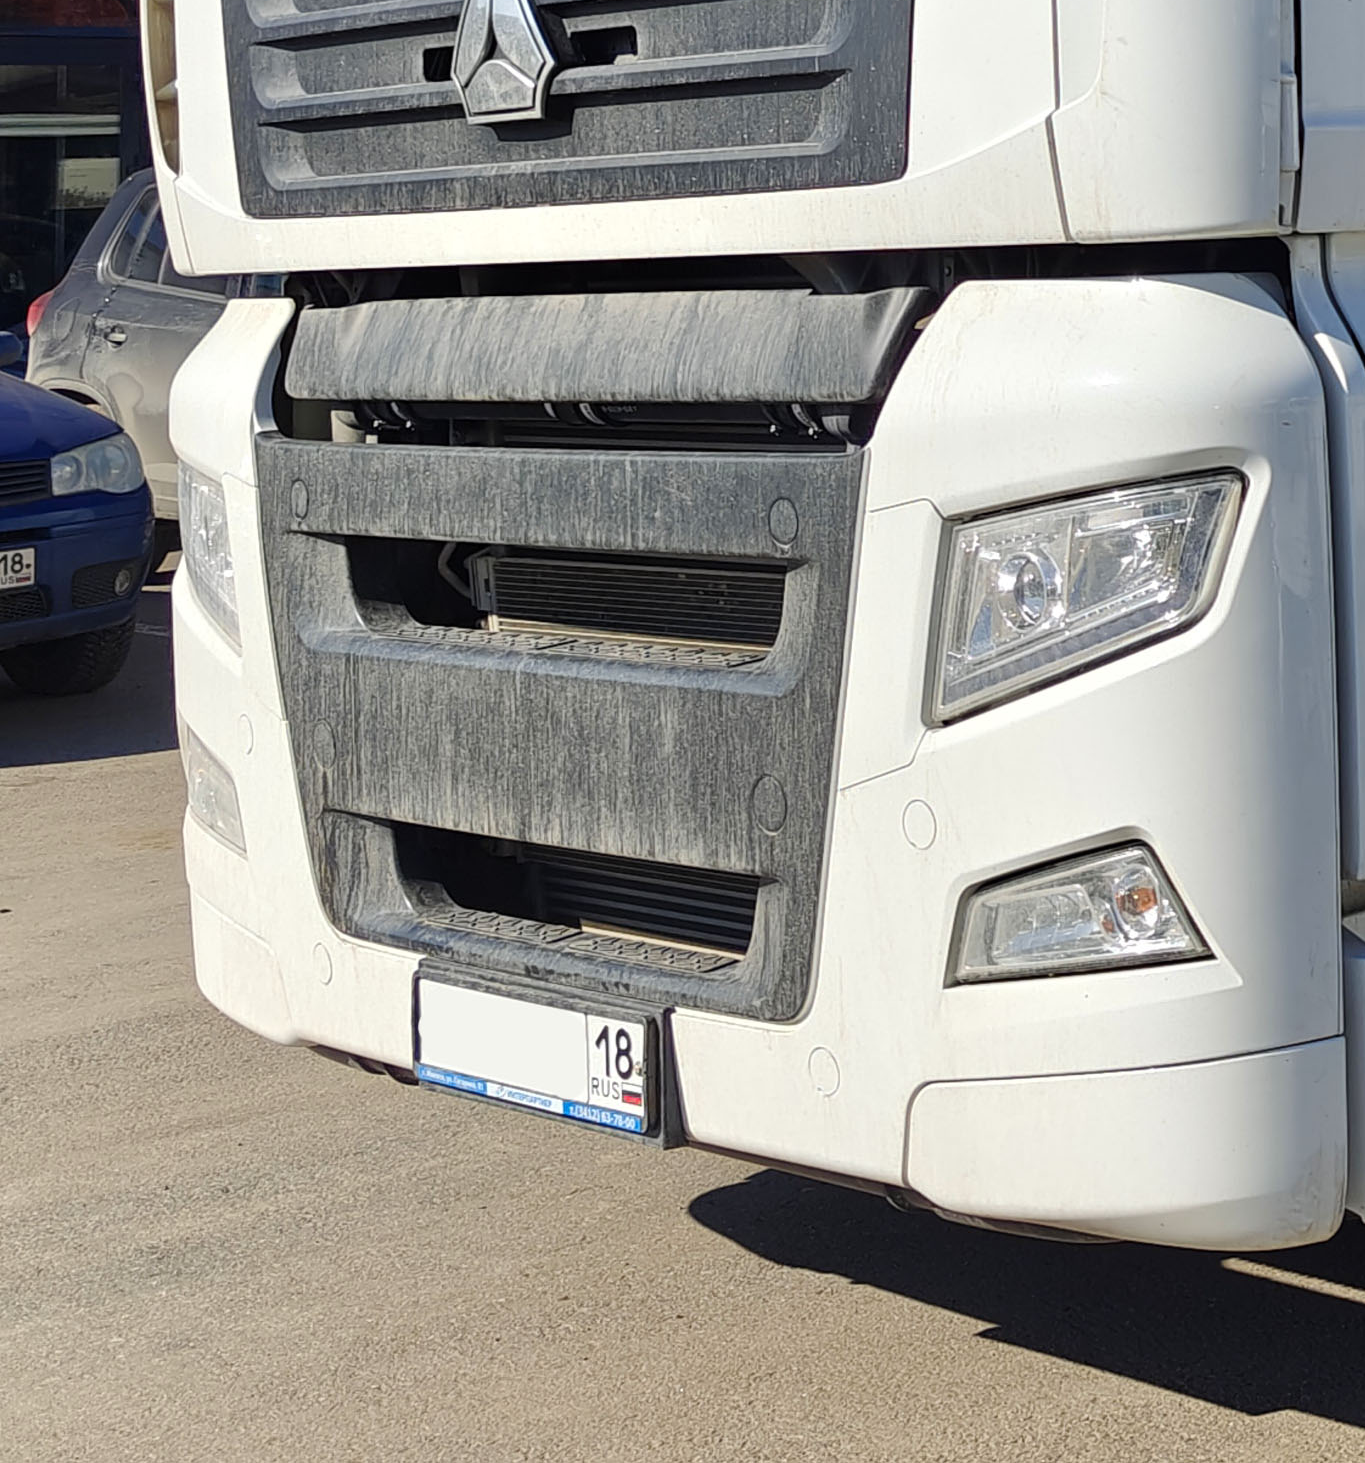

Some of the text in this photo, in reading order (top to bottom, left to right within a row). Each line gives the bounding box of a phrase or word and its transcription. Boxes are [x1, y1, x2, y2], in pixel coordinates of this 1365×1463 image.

[0, 552, 24, 576] 18
[595, 1024, 634, 1080] 18
[591, 1077, 621, 1100] RUS
